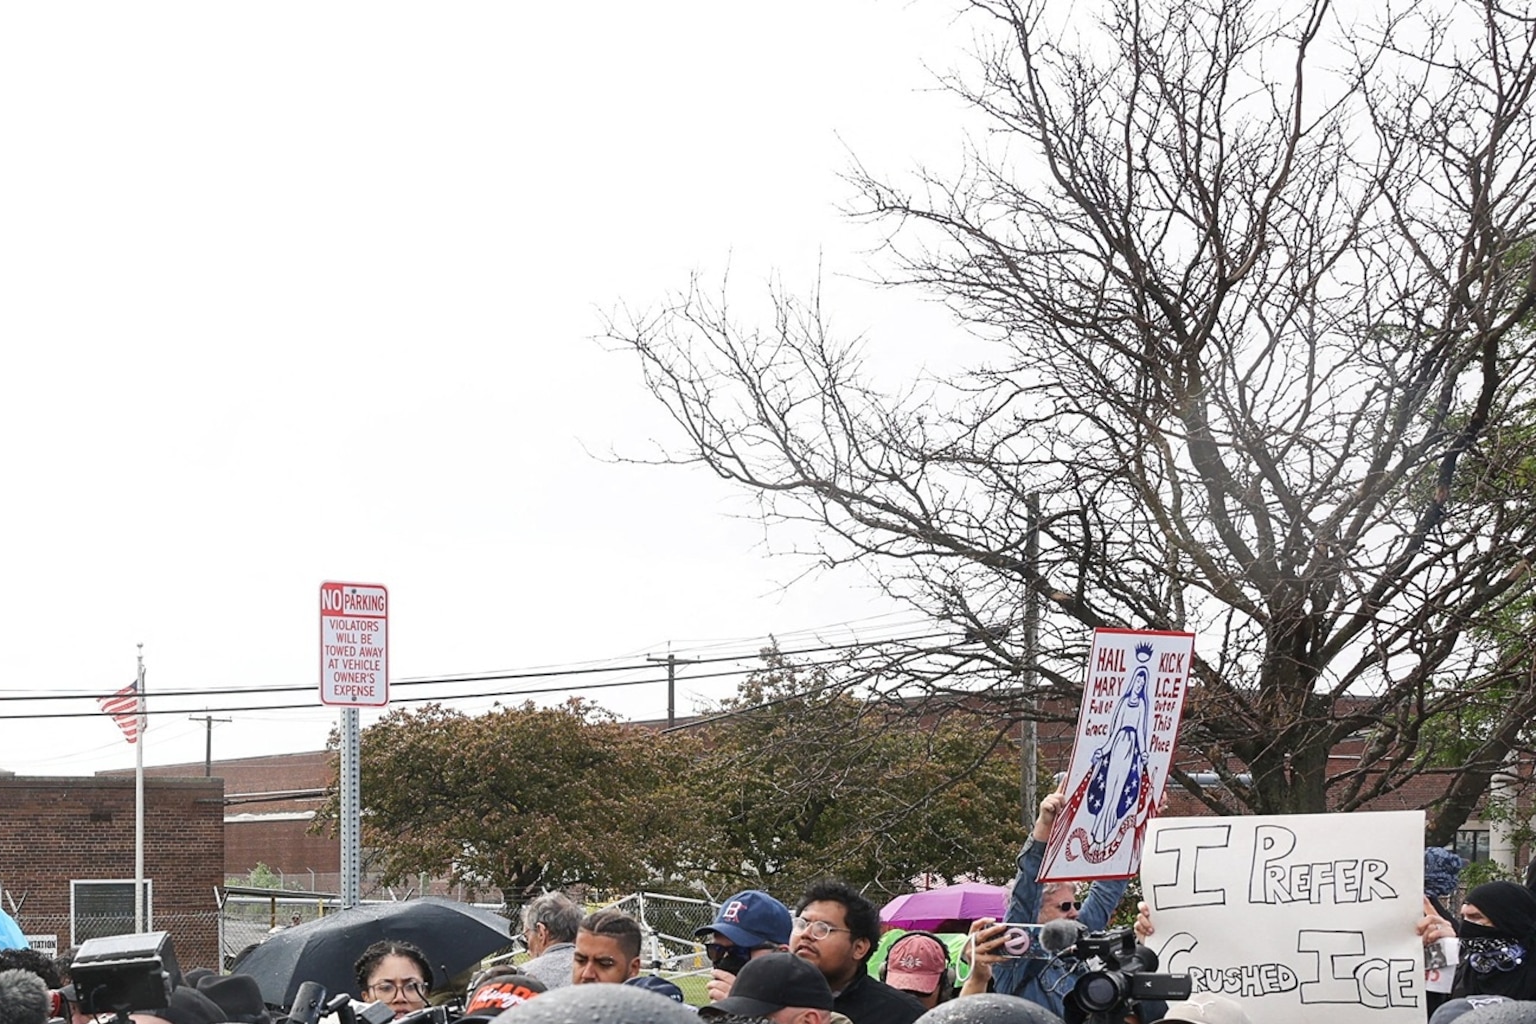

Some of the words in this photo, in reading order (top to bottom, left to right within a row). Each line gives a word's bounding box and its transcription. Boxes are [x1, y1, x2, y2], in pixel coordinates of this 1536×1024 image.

[322, 589, 342, 610] NO
[345, 594, 384, 611] PARKING
[330, 619, 379, 632] VIOLATORS
[336, 633, 357, 644] WILL
[361, 634, 372, 644] BE
[325, 645, 356, 657] TOWED
[359, 647, 384, 658] AWAY
[328, 659, 339, 669] AT
[342, 660, 380, 671] VEHICLE
[1097, 648, 1126, 672] HAIL
[1159, 653, 1185, 673] KICK
[334, 672, 375, 683] OWNER'S
[334, 685, 375, 697] EXPENSE
[1093, 676, 1125, 697] MARY
[1153, 714, 1172, 731] This
[1153, 825, 1231, 910] I
